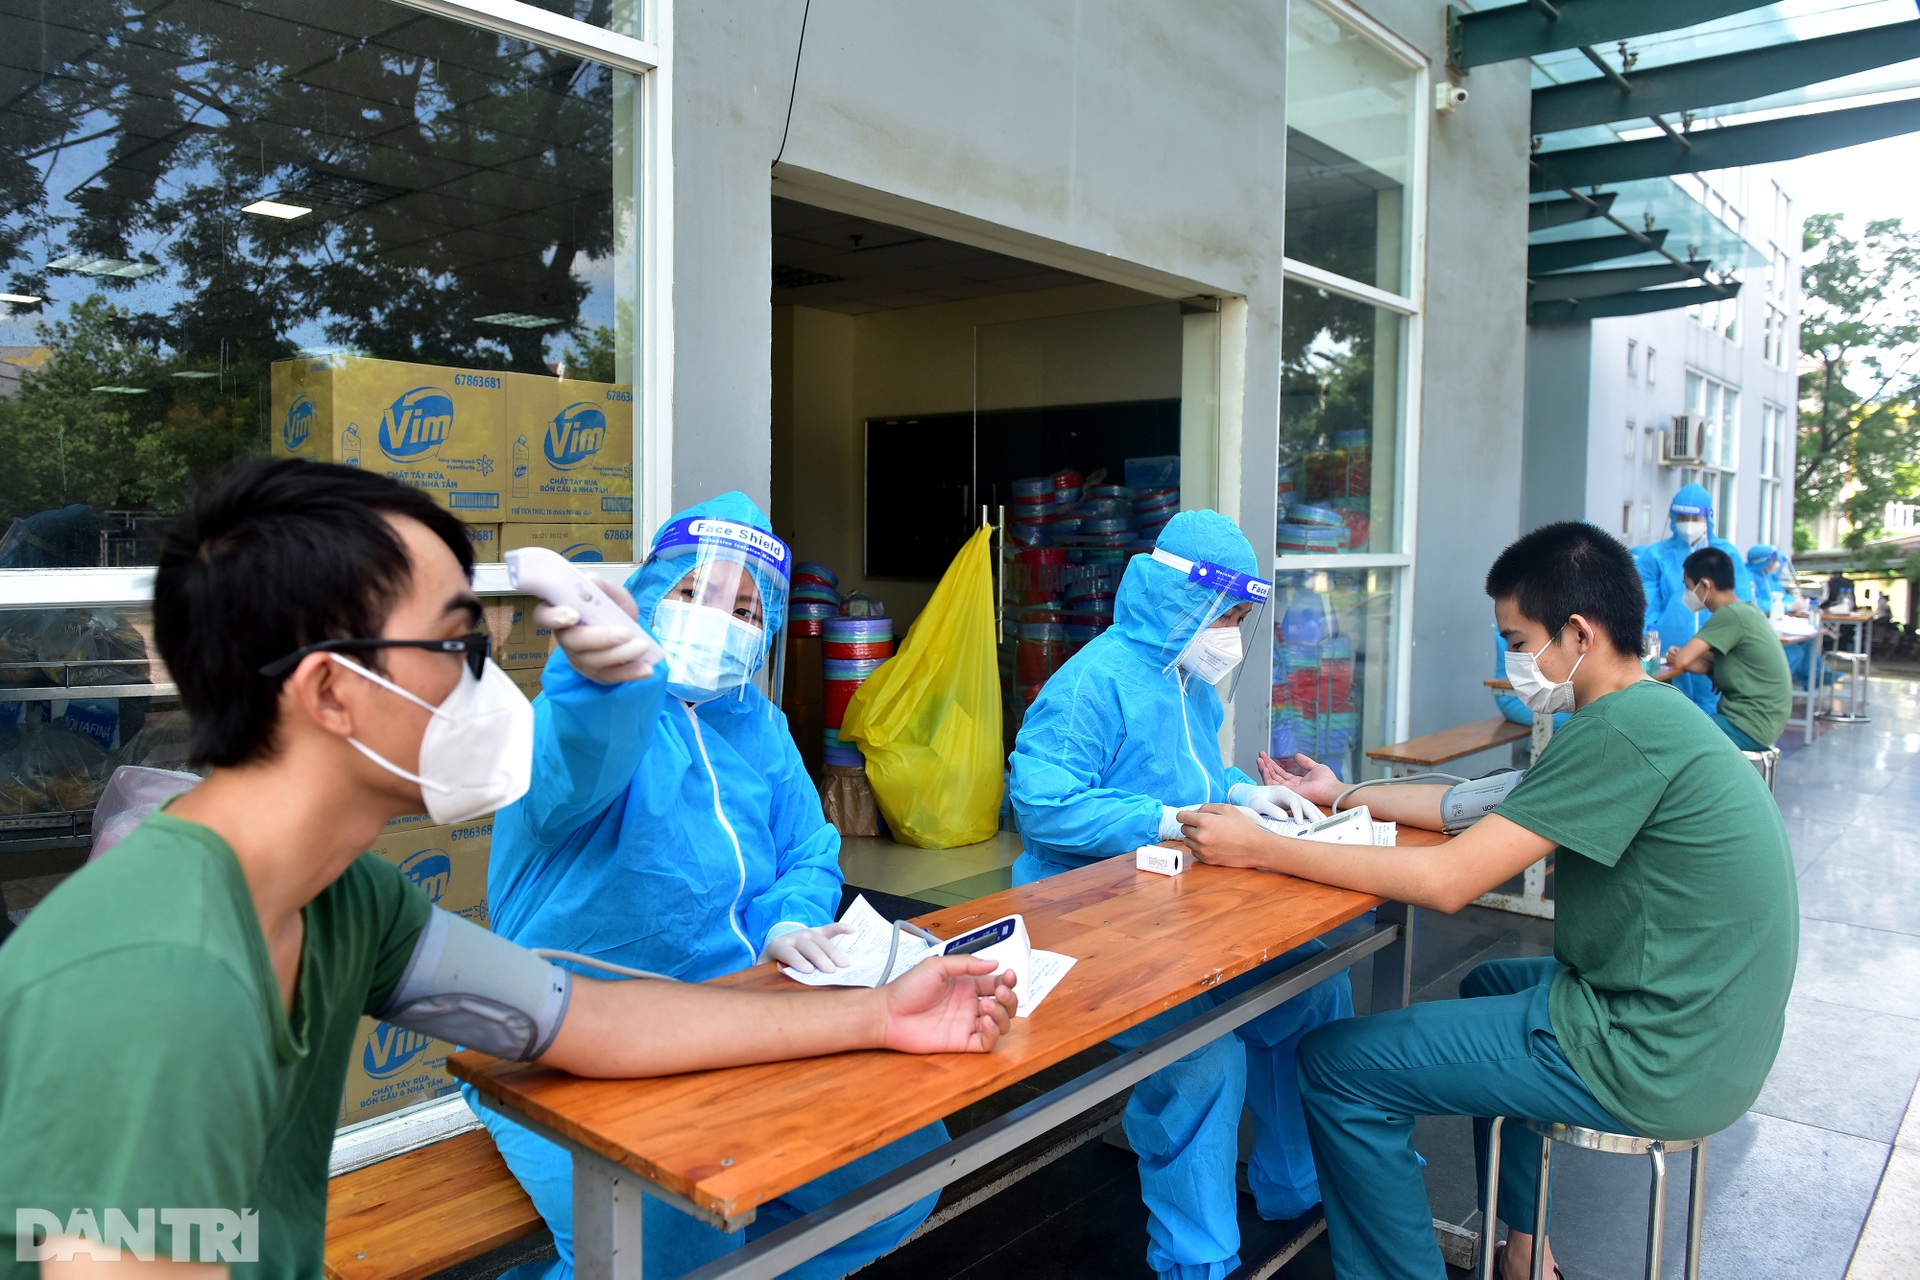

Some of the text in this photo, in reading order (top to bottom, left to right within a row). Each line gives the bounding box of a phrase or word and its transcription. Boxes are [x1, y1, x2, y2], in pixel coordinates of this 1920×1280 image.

[454, 374, 501, 389] 67863681
[606, 390, 633, 402] 67863
[287, 412, 312, 443] Vim
[384, 408, 451, 449] Vim
[548, 421, 604, 458] Vim
[697, 523, 781, 556] Face Shield
